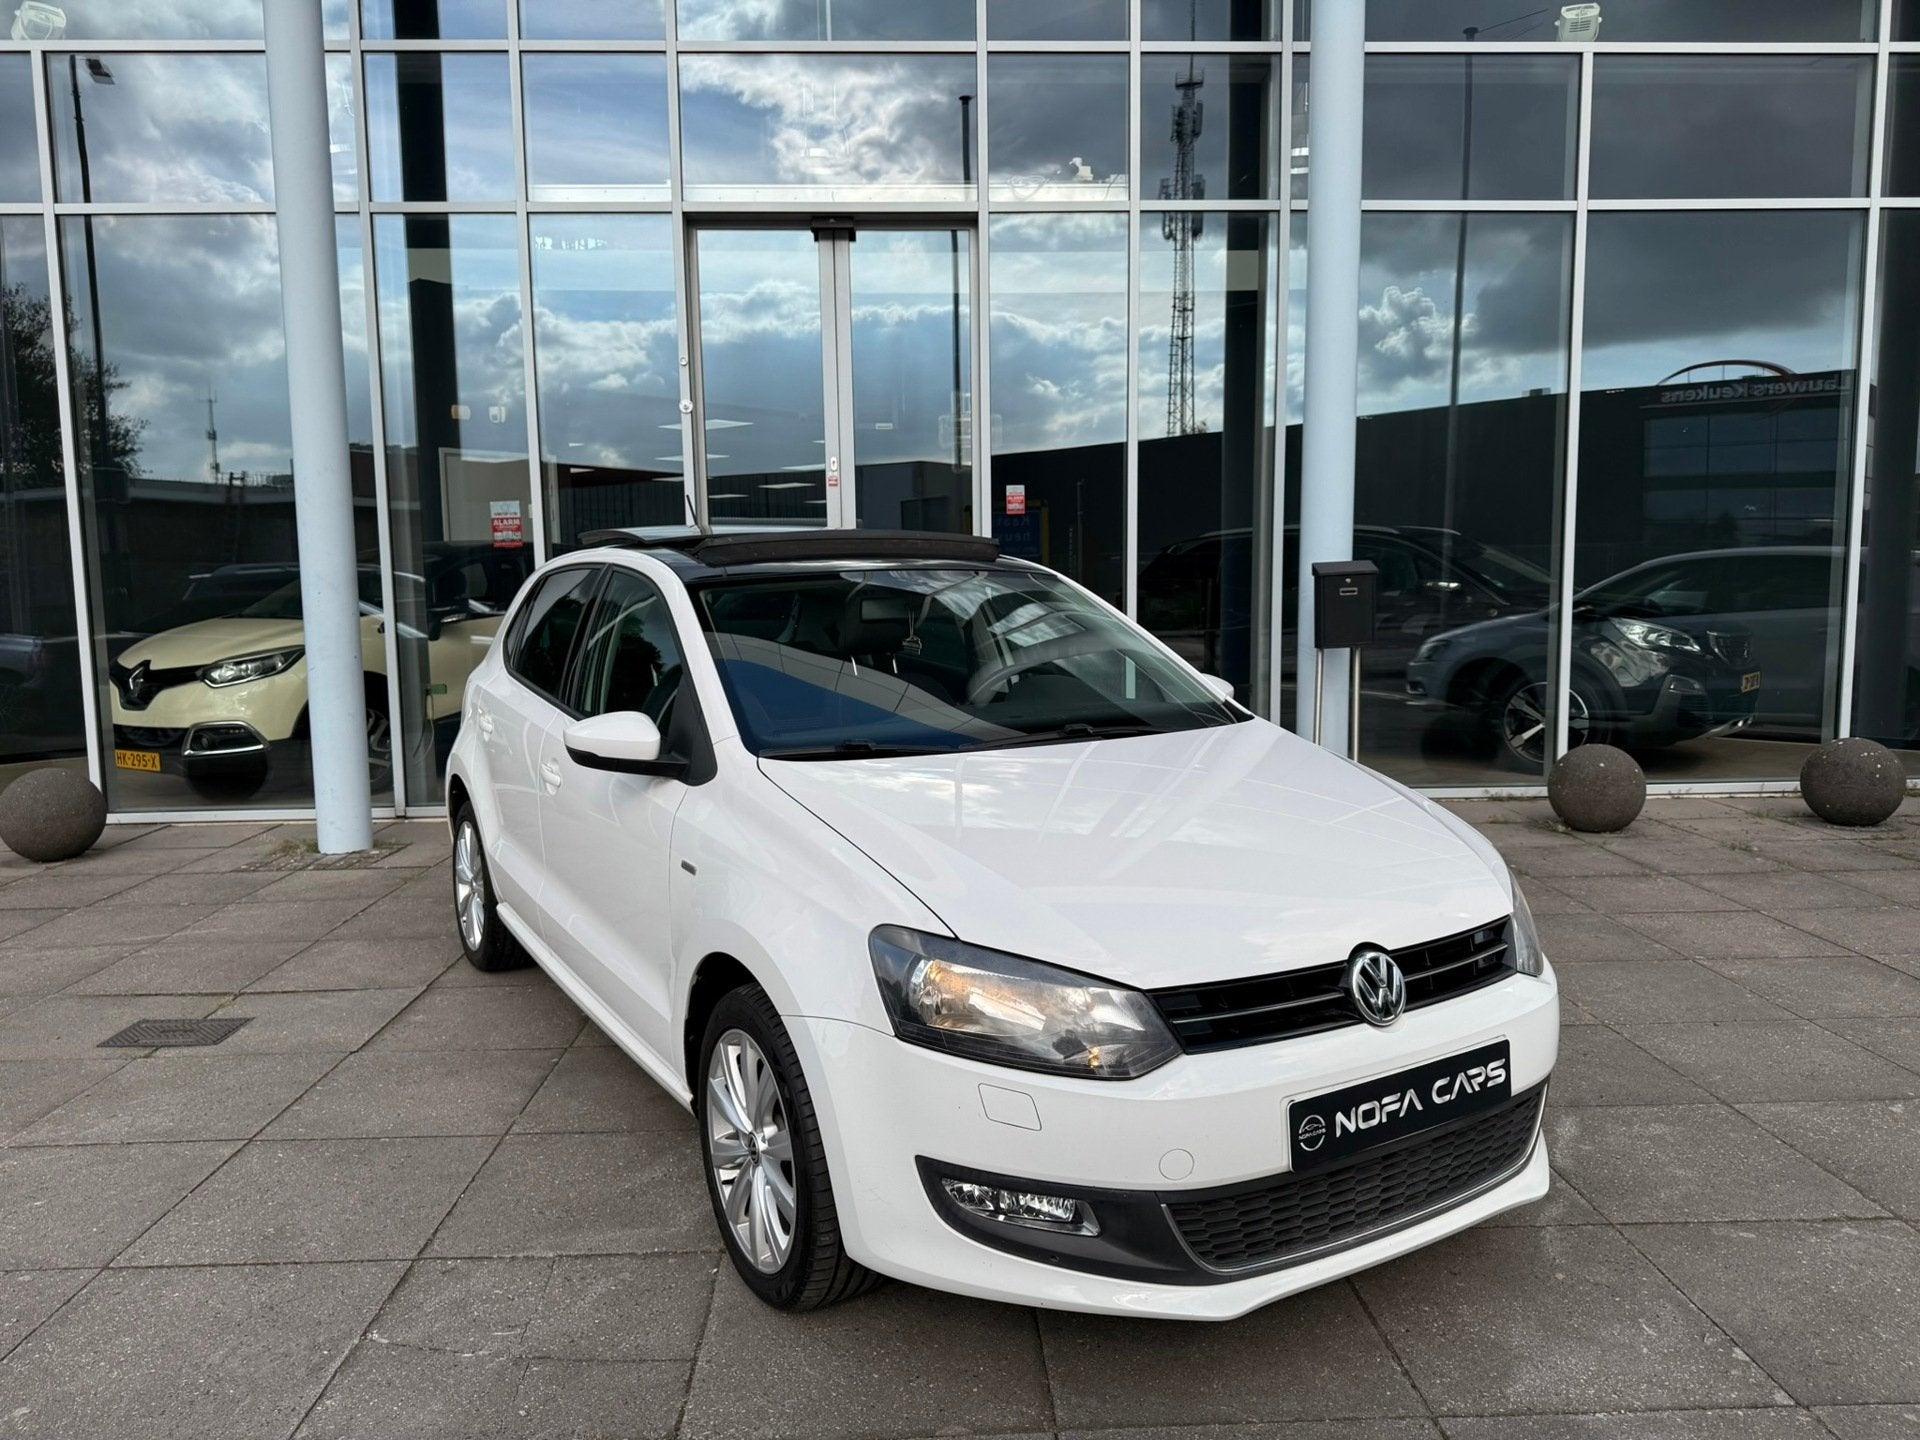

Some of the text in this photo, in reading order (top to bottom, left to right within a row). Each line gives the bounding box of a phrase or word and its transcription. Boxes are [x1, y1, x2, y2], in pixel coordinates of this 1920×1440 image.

[493, 518, 520, 526] ALARM
[116, 752, 157, 769] HK-295-X
[1335, 1058, 1506, 1138] NOFA CARS
